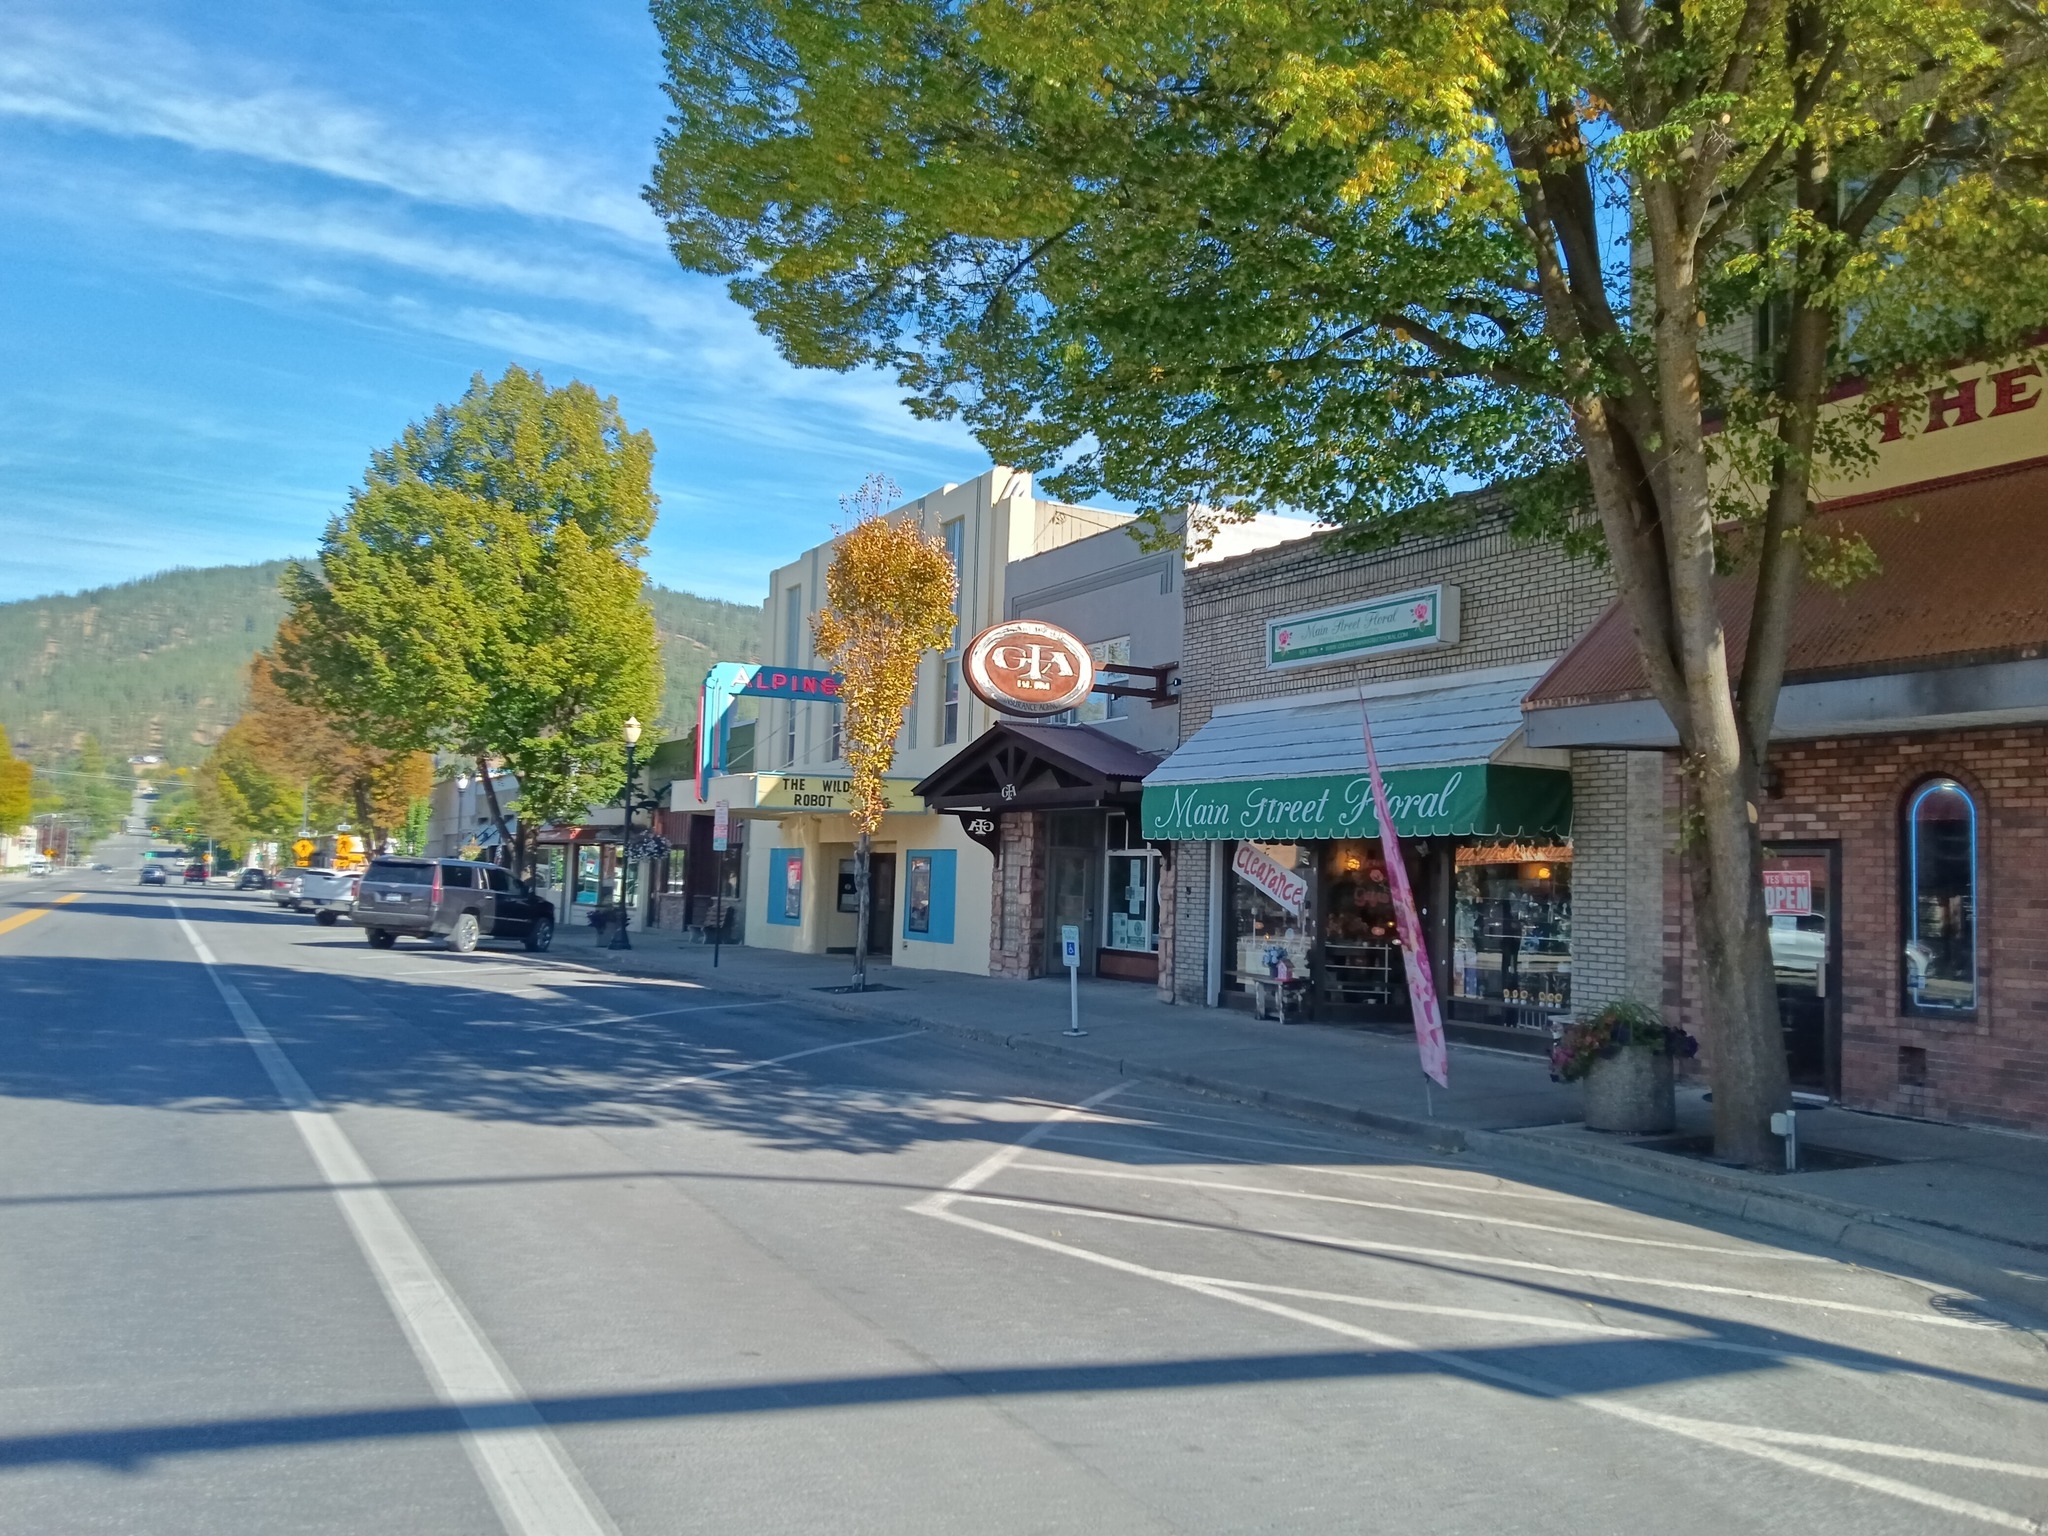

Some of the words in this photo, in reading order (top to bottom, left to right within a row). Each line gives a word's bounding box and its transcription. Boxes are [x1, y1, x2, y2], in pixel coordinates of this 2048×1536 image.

[1869, 364, 2042, 443] THE
[1300, 624, 1328, 640] Main
[1331, 617, 1361, 636] Street
[1363, 606, 1399, 627] Floral
[730, 666, 838, 696] ALPINE
[783, 778, 805, 791] THE
[822, 779, 850, 793] WILD
[794, 794, 833, 808] ROBOT
[1155, 788, 1229, 828] Main
[1240, 787, 1330, 826] Street
[1235, 844, 1306, 906] Clearance
[1765, 875, 1780, 884] YES
[1764, 886, 1809, 909] OPEN
